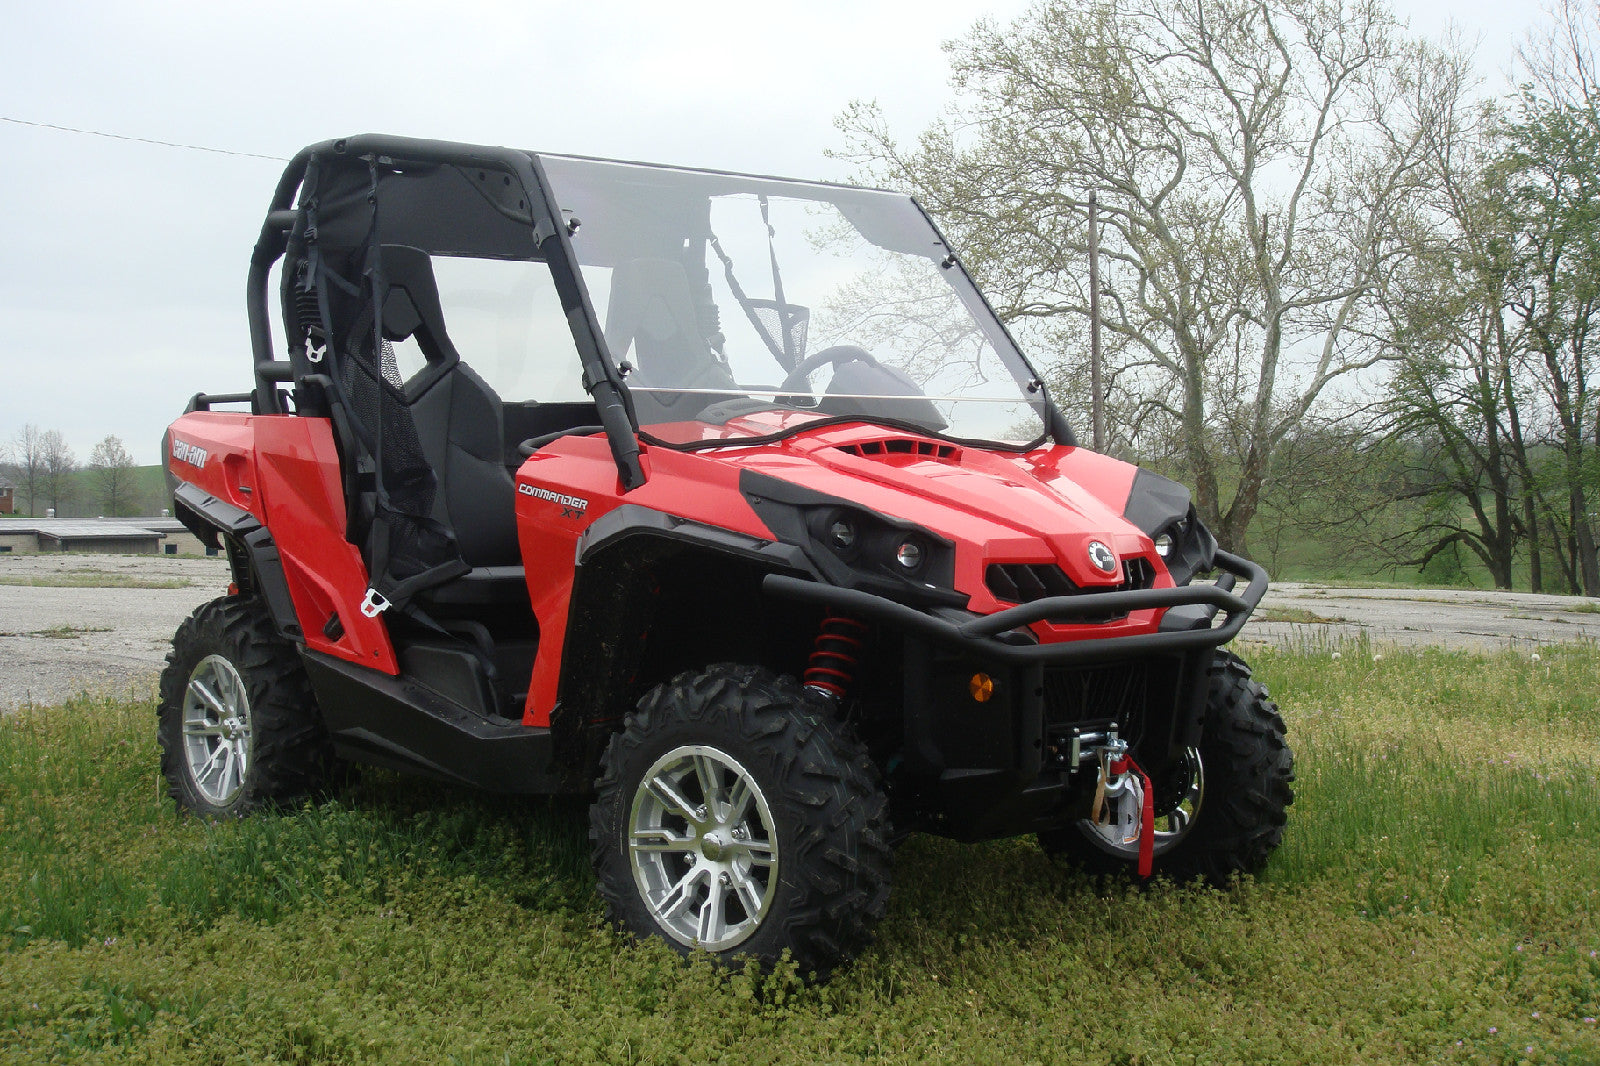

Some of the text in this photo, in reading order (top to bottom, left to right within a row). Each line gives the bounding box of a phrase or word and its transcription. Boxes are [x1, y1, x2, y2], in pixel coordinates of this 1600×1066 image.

[173, 439, 207, 469] can-am
[518, 483, 588, 510] COMMANDER
[561, 507, 585, 519] XT
